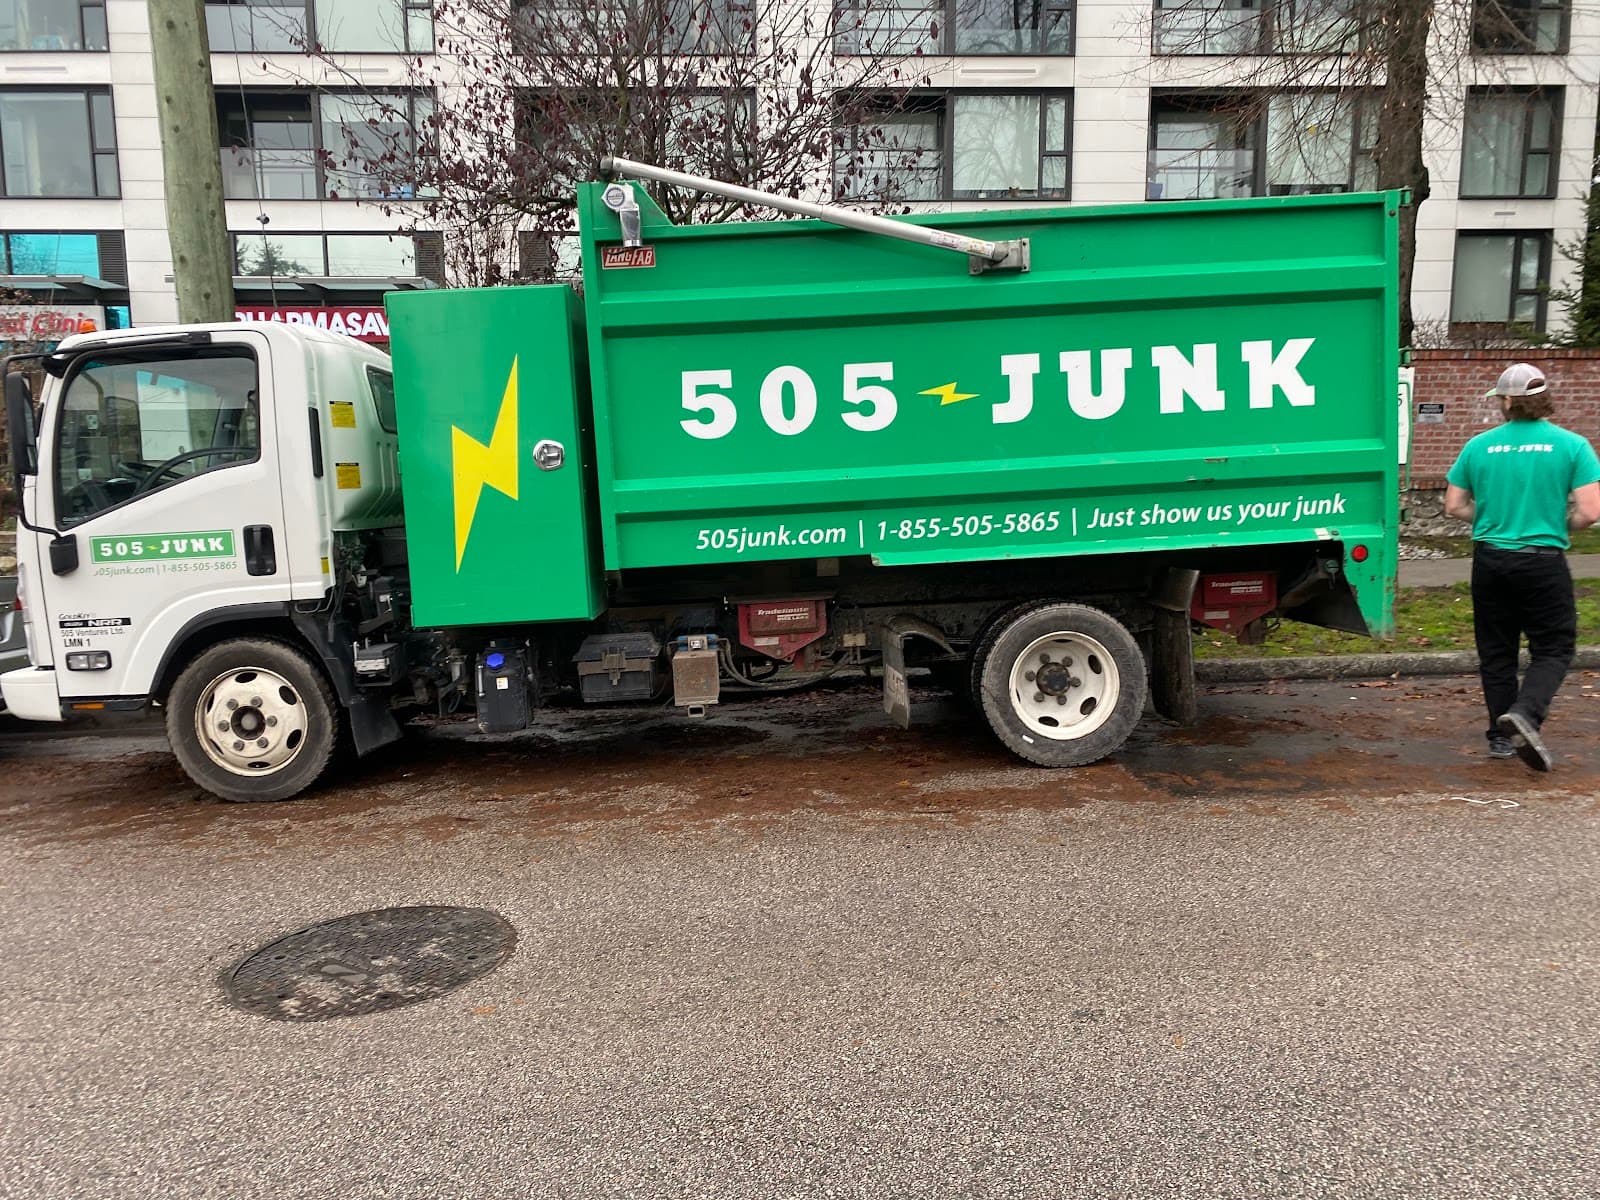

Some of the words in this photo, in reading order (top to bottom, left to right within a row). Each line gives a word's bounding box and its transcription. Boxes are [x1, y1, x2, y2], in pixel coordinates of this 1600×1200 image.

[680, 361, 899, 440] 505
[992, 337, 1318, 424] JUNK
[1487, 444, 1513, 454] 505
[1518, 443, 1554, 453] JUNK
[696, 525, 847, 554] 505junk.com
[877, 511, 1061, 541] 1-855-505-5865
[1087, 507, 1136, 529] Just
[1140, 503, 1202, 526] show
[1207, 504, 1233, 522] us
[1237, 500, 1292, 526] your
[1292, 492, 1348, 523] junk
[100, 541, 144, 557] 505
[160, 537, 225, 554] JUNK
[162, 561, 238, 574] 1-855-505-5865
[87, 619, 122, 627] NRR
[63, 638, 83, 647] LMN
[86, 638, 91, 647] 1
